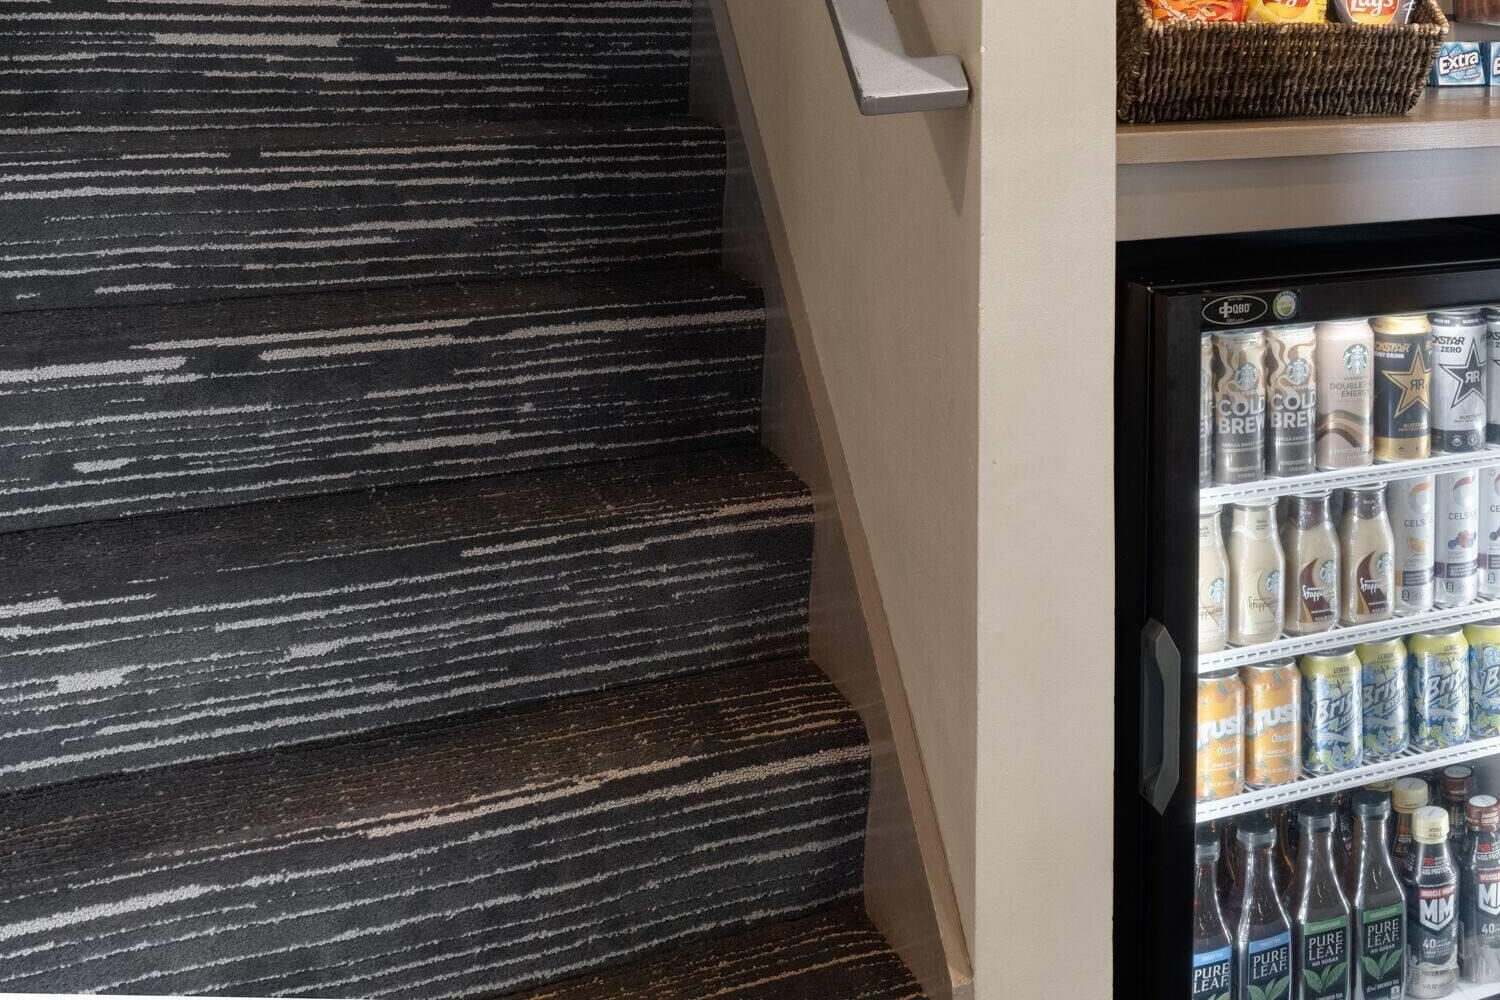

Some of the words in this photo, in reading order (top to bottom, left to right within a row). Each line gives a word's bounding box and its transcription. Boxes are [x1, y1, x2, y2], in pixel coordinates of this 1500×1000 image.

[1439, 51, 1479, 75] Extra
[1232, 303, 1250, 314] QBD
[1432, 334, 1465, 346] CKSTAR
[1440, 346, 1462, 354] ZERO
[1218, 396, 1265, 416] COLD
[1271, 391, 1316, 410] COLD
[1218, 413, 1265, 434] BREW
[1271, 408, 1316, 429] BREW
[1421, 889, 1442, 897] MUSCLE
[1367, 918, 1399, 937] PURE
[1481, 923, 1495, 934] 40
[1308, 931, 1343, 949] PURE
[1380, 943, 1396, 952] SUGAR
[1422, 938, 1436, 949] 40
[1253, 947, 1287, 967] PURE
[1321, 956, 1339, 965] SUGAR
[1194, 962, 1230, 982] PURE
